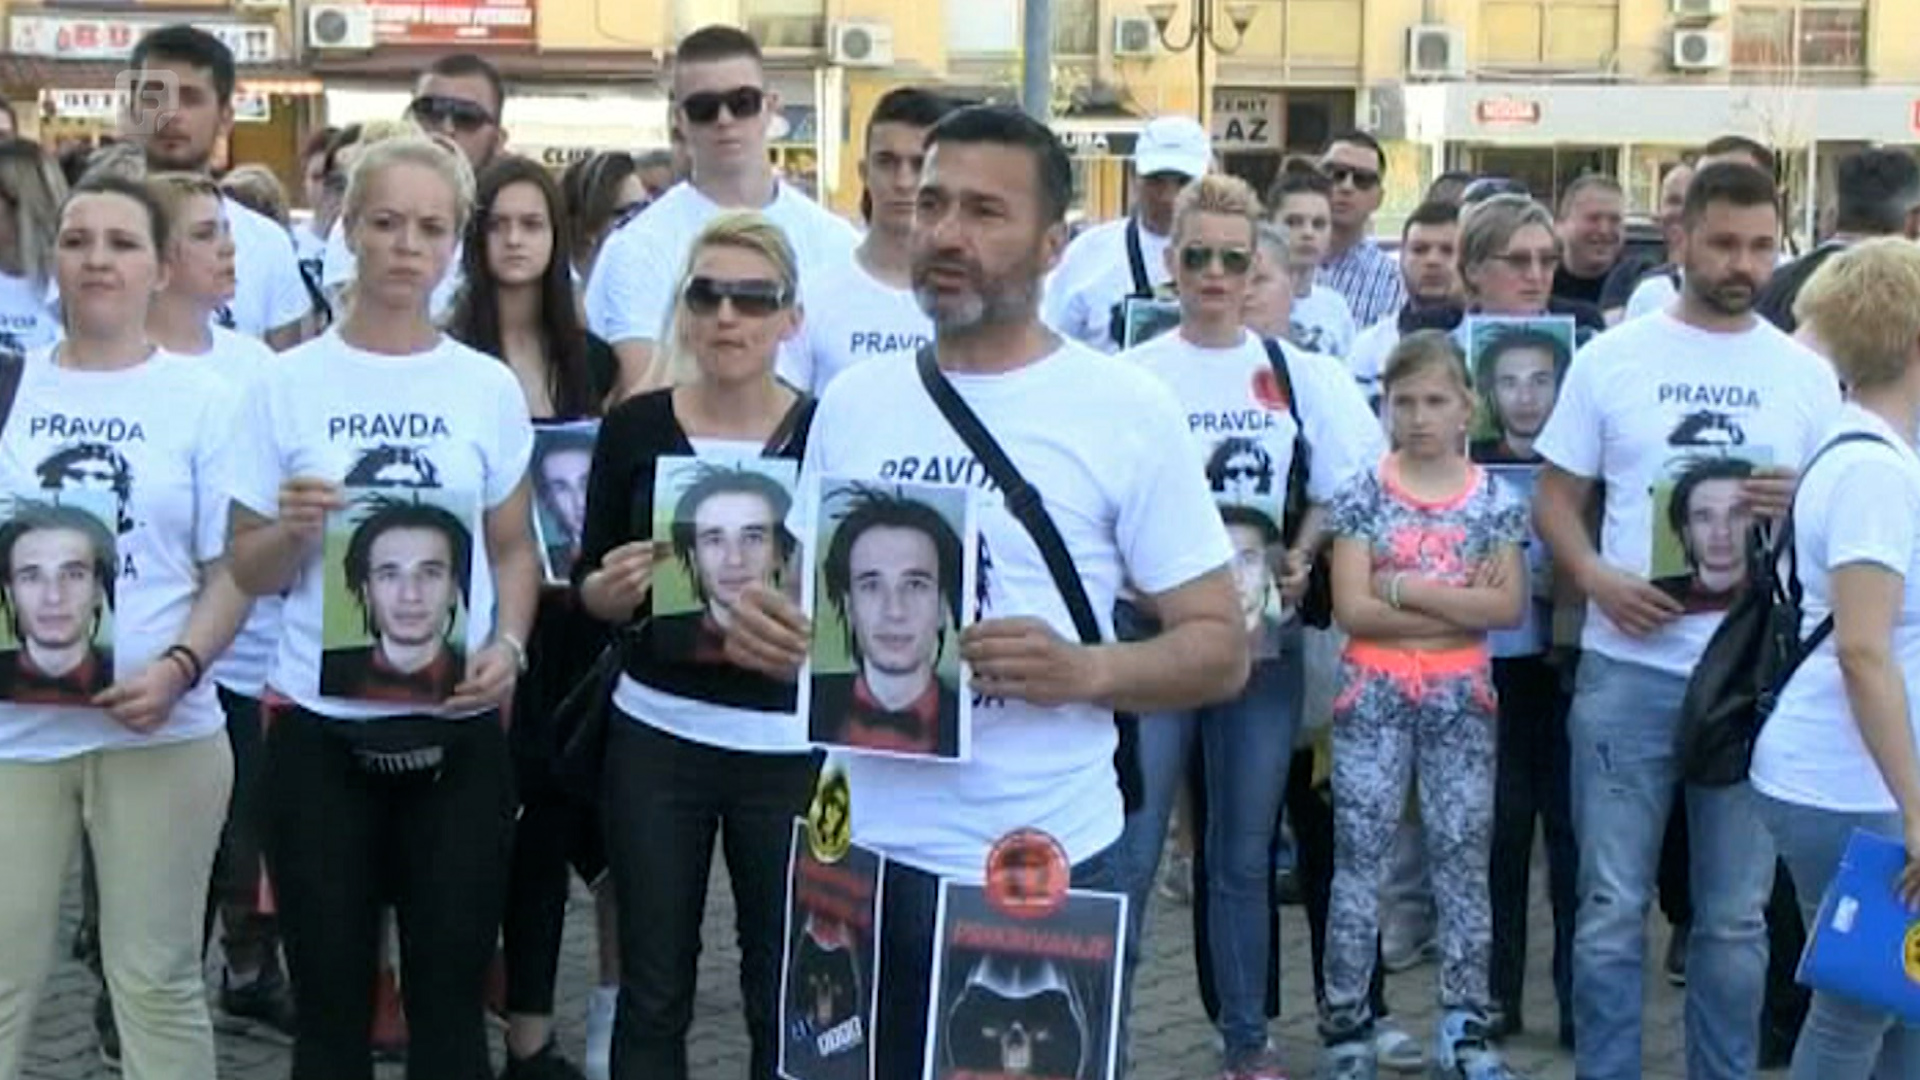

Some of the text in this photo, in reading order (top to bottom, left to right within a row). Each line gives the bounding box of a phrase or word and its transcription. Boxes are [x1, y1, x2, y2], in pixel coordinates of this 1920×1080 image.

[850, 332, 929, 354] PRAVD
[1659, 383, 1761, 410] PRAVDA
[30, 413, 146, 442] PRAVDA
[329, 413, 450, 441] PRAVDA
